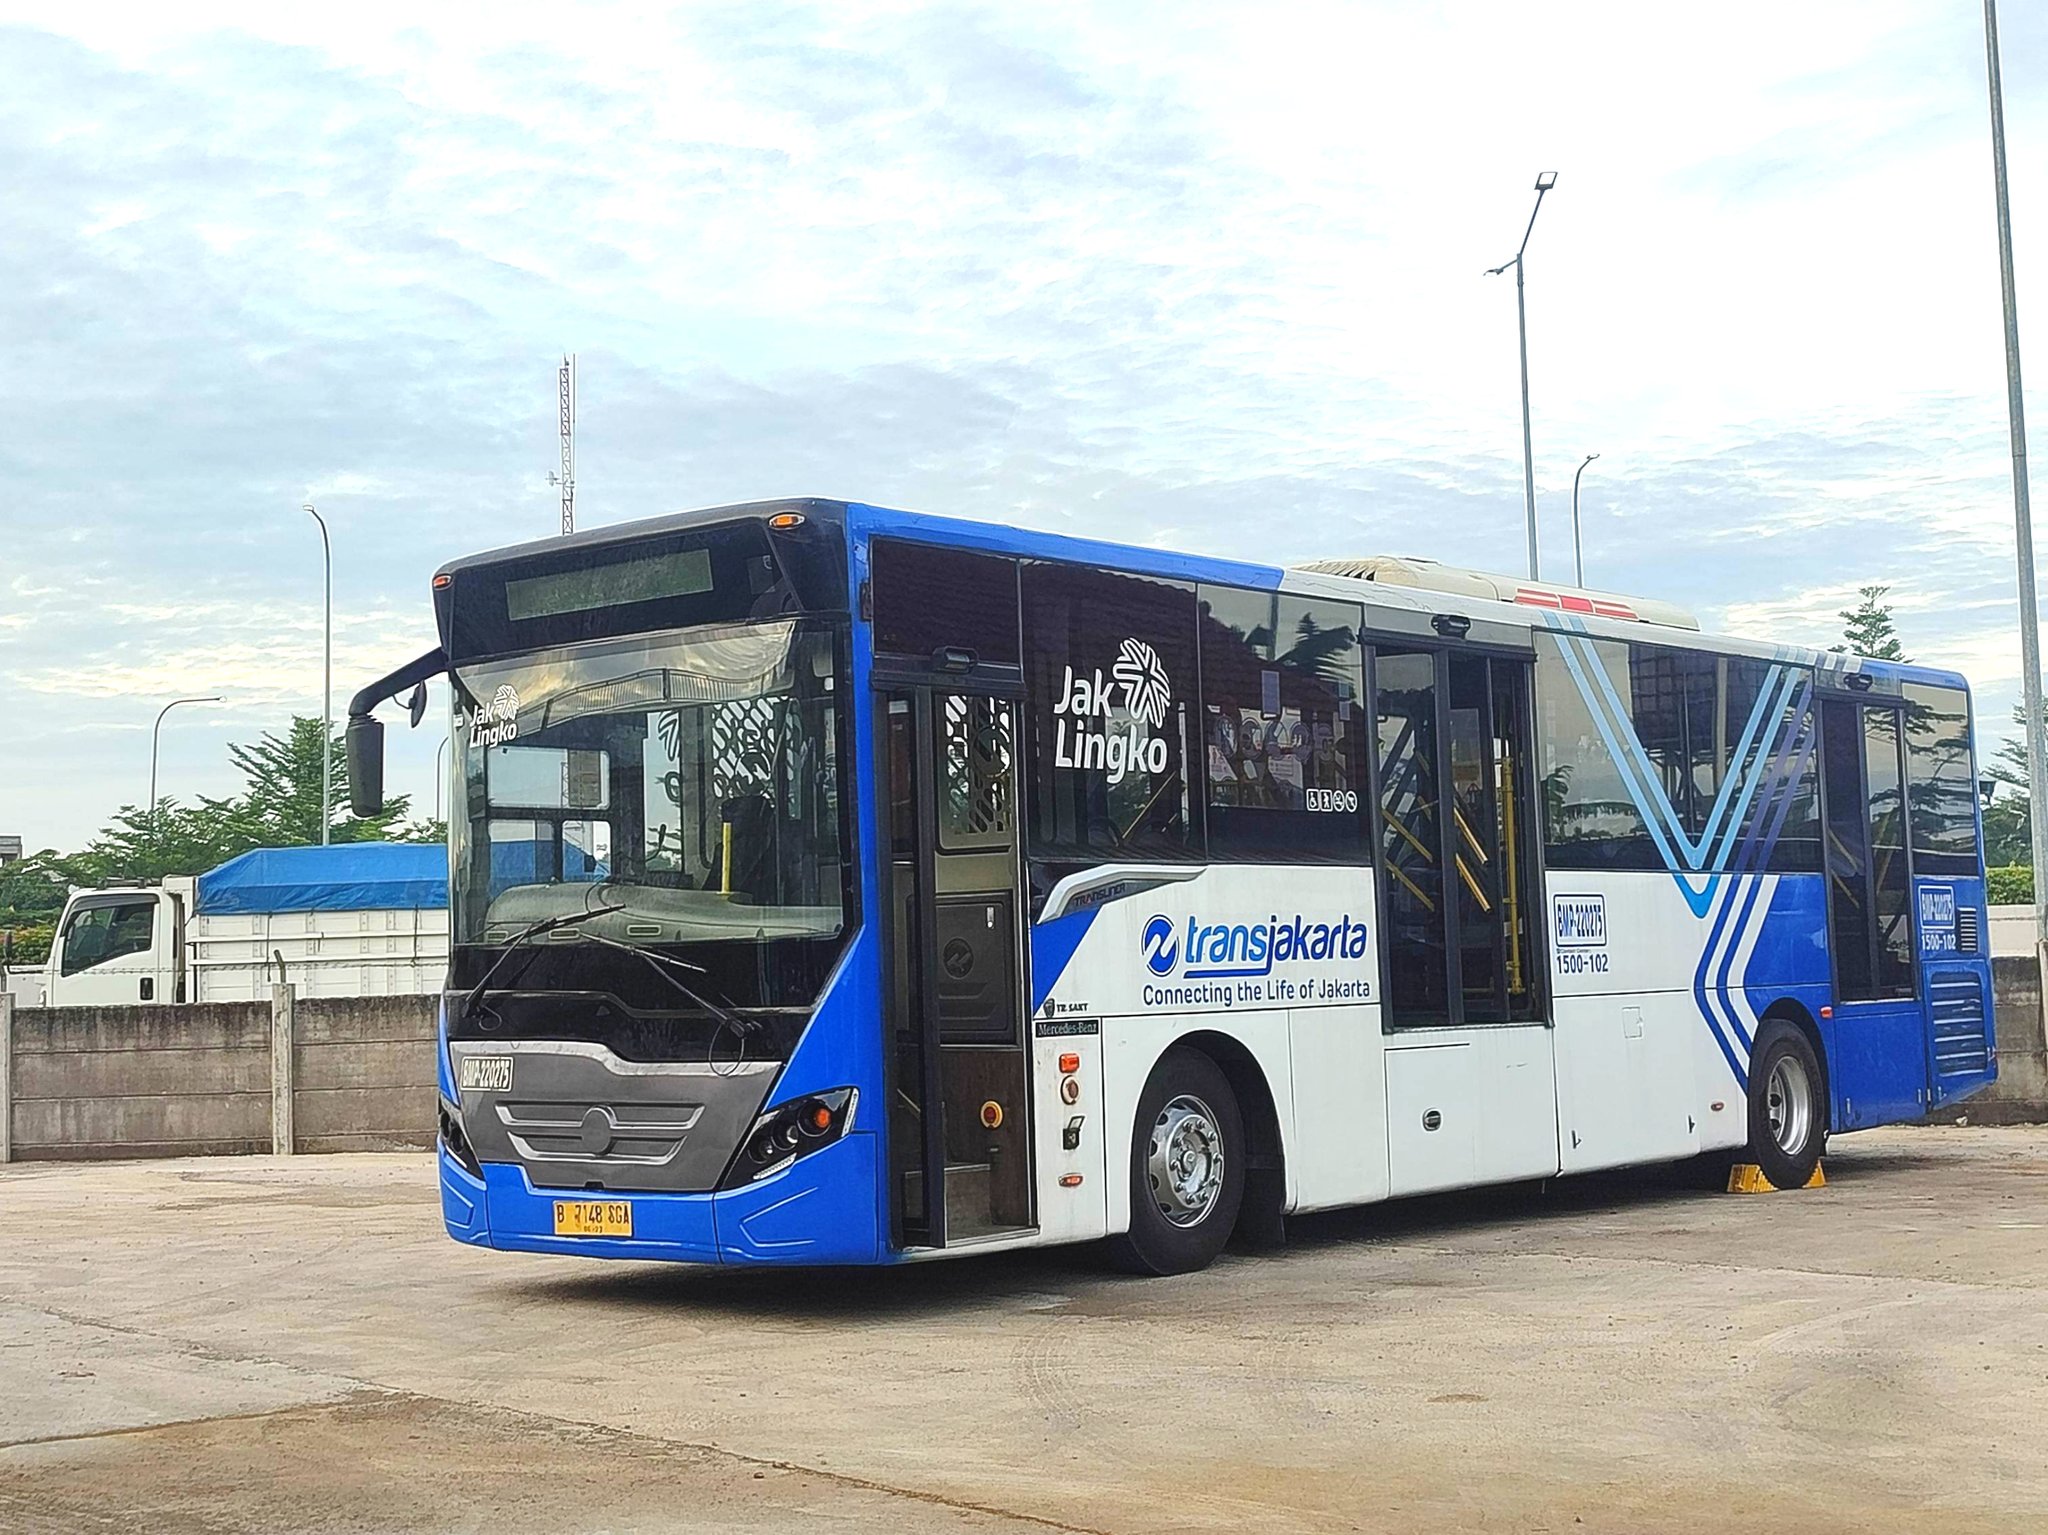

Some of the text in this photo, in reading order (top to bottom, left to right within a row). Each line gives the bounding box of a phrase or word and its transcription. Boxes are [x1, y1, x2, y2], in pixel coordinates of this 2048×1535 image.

[1053, 665, 1115, 717] Jak
[469, 702, 495, 727] Jak
[469, 720, 518, 749] Lingko
[1055, 718, 1168, 784] Lingko
[1557, 904, 1603, 937] BMP-220275
[1184, 914, 1368, 979] transjakarta
[1921, 934, 1957, 951] 1500-102
[1556, 953, 1609, 974] 1500-102
[1143, 978, 1371, 1007] Connecting the Life of Jakarta
[1039, 1022, 1097, 1035] Mercedes-Benz
[556, 1204, 630, 1225] B 7148 SGA
